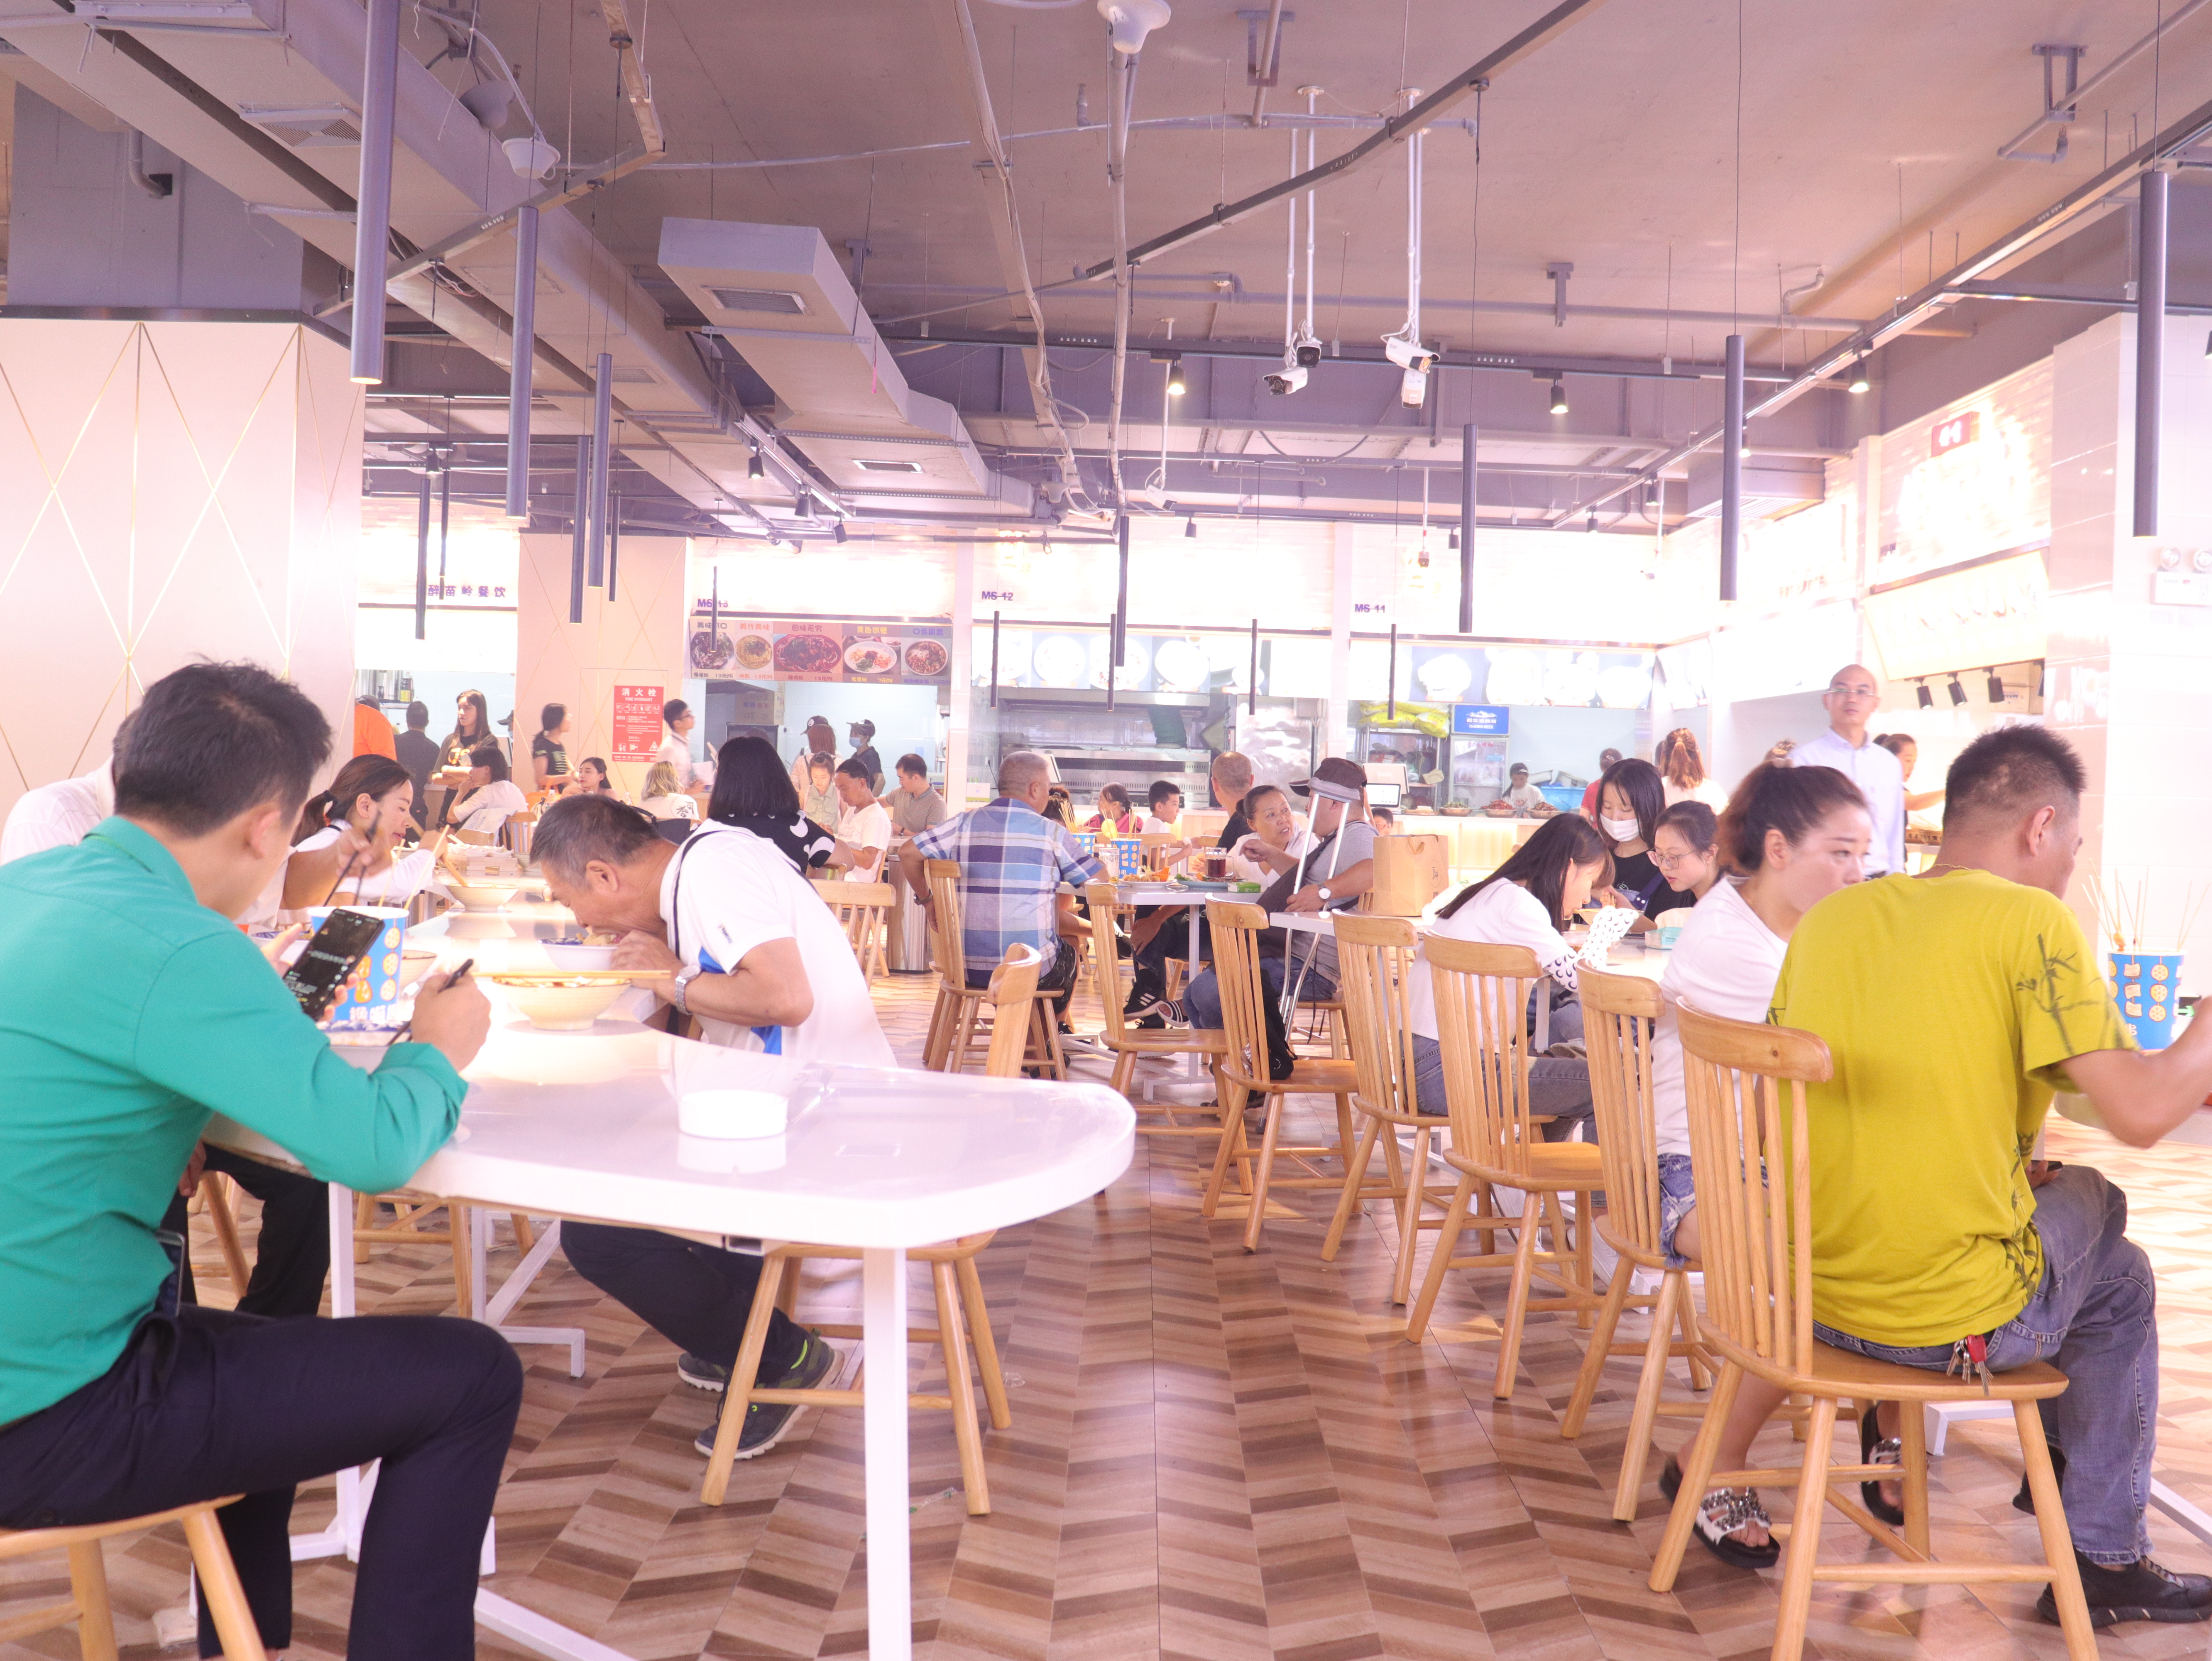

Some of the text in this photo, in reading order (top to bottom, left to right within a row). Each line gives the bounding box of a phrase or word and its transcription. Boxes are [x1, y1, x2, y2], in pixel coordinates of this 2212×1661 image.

[857, 625, 888, 635] 秀色可餐
[622, 688, 656, 697] 消火栓
